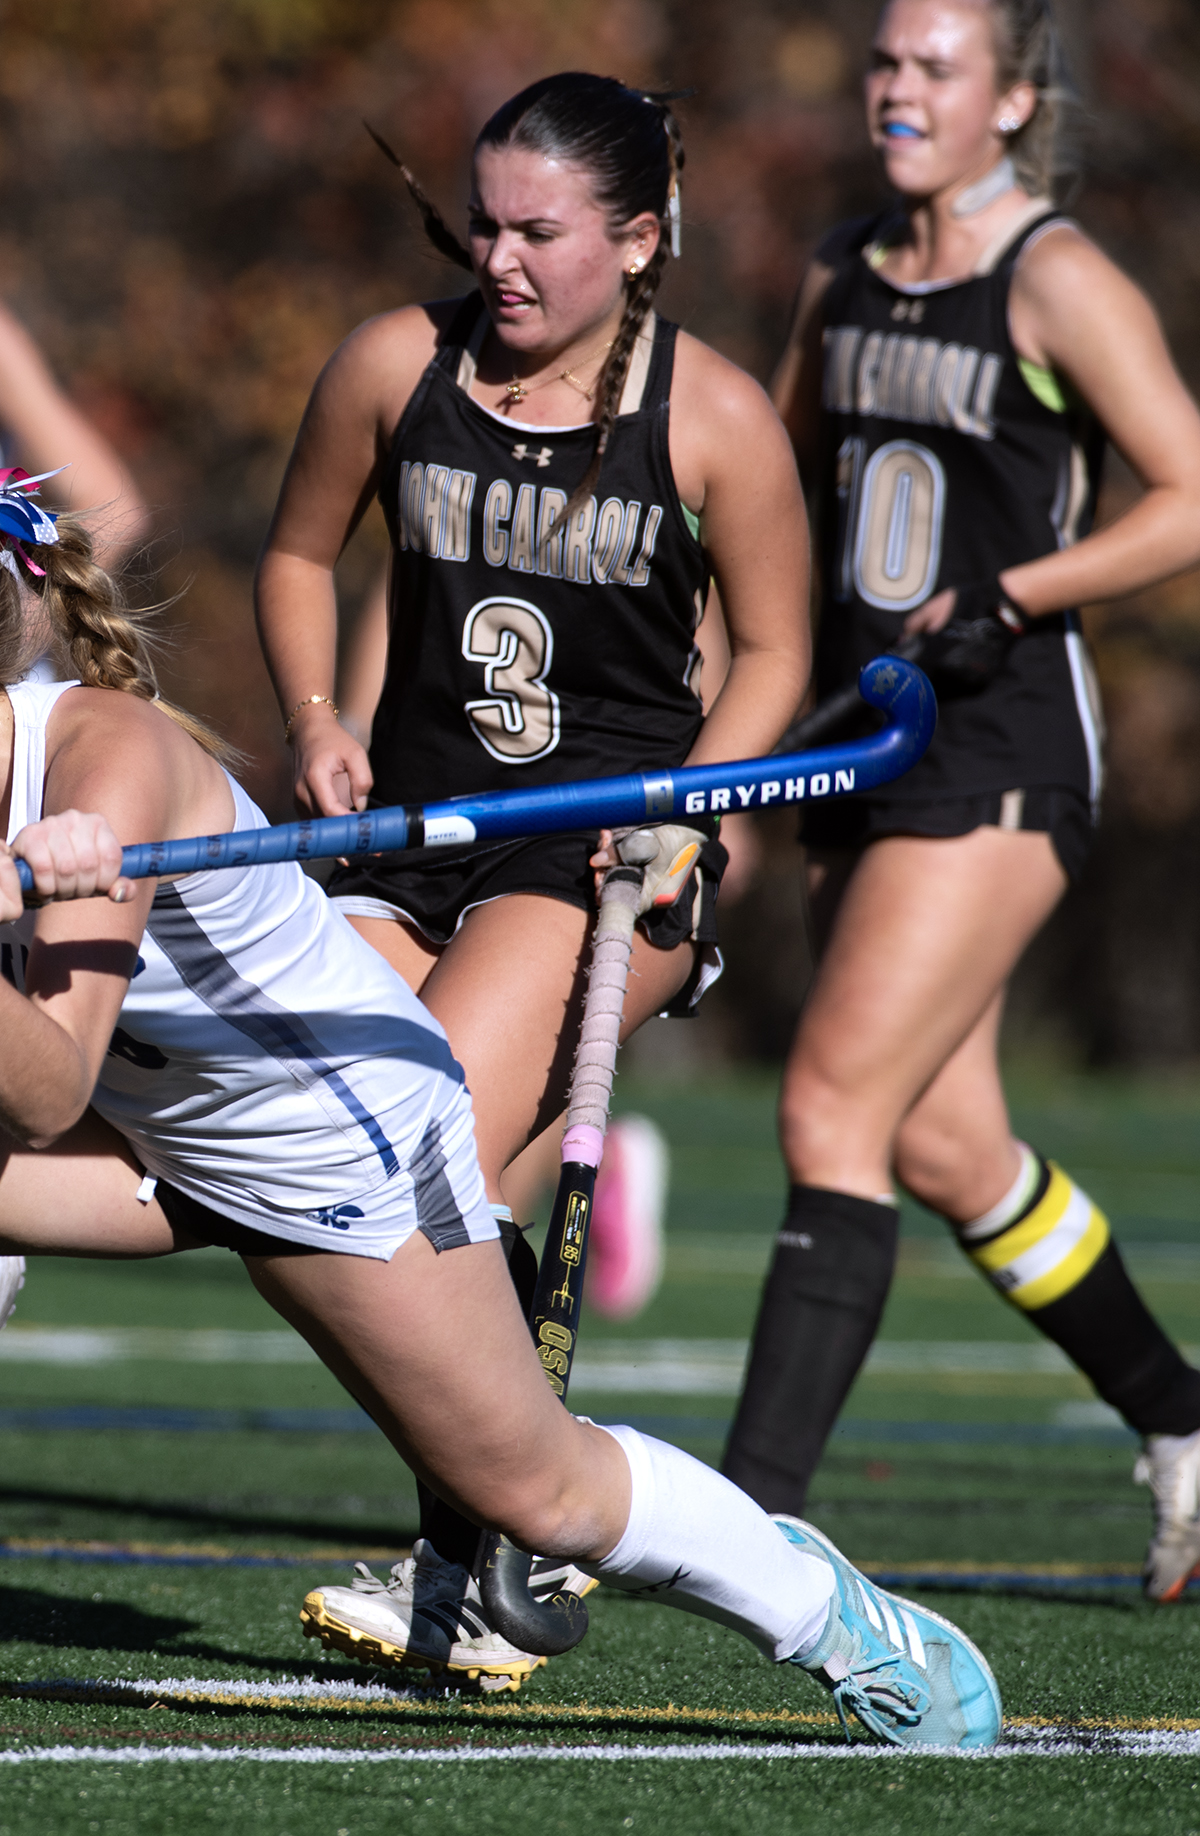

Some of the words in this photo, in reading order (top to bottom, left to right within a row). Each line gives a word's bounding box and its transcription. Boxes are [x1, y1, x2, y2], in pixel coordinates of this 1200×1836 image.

[483, 478, 663, 586] CARROLL
[462, 596, 560, 764] 3
[685, 768, 855, 814] GRYPHON
[563, 1244, 579, 1262] 85
